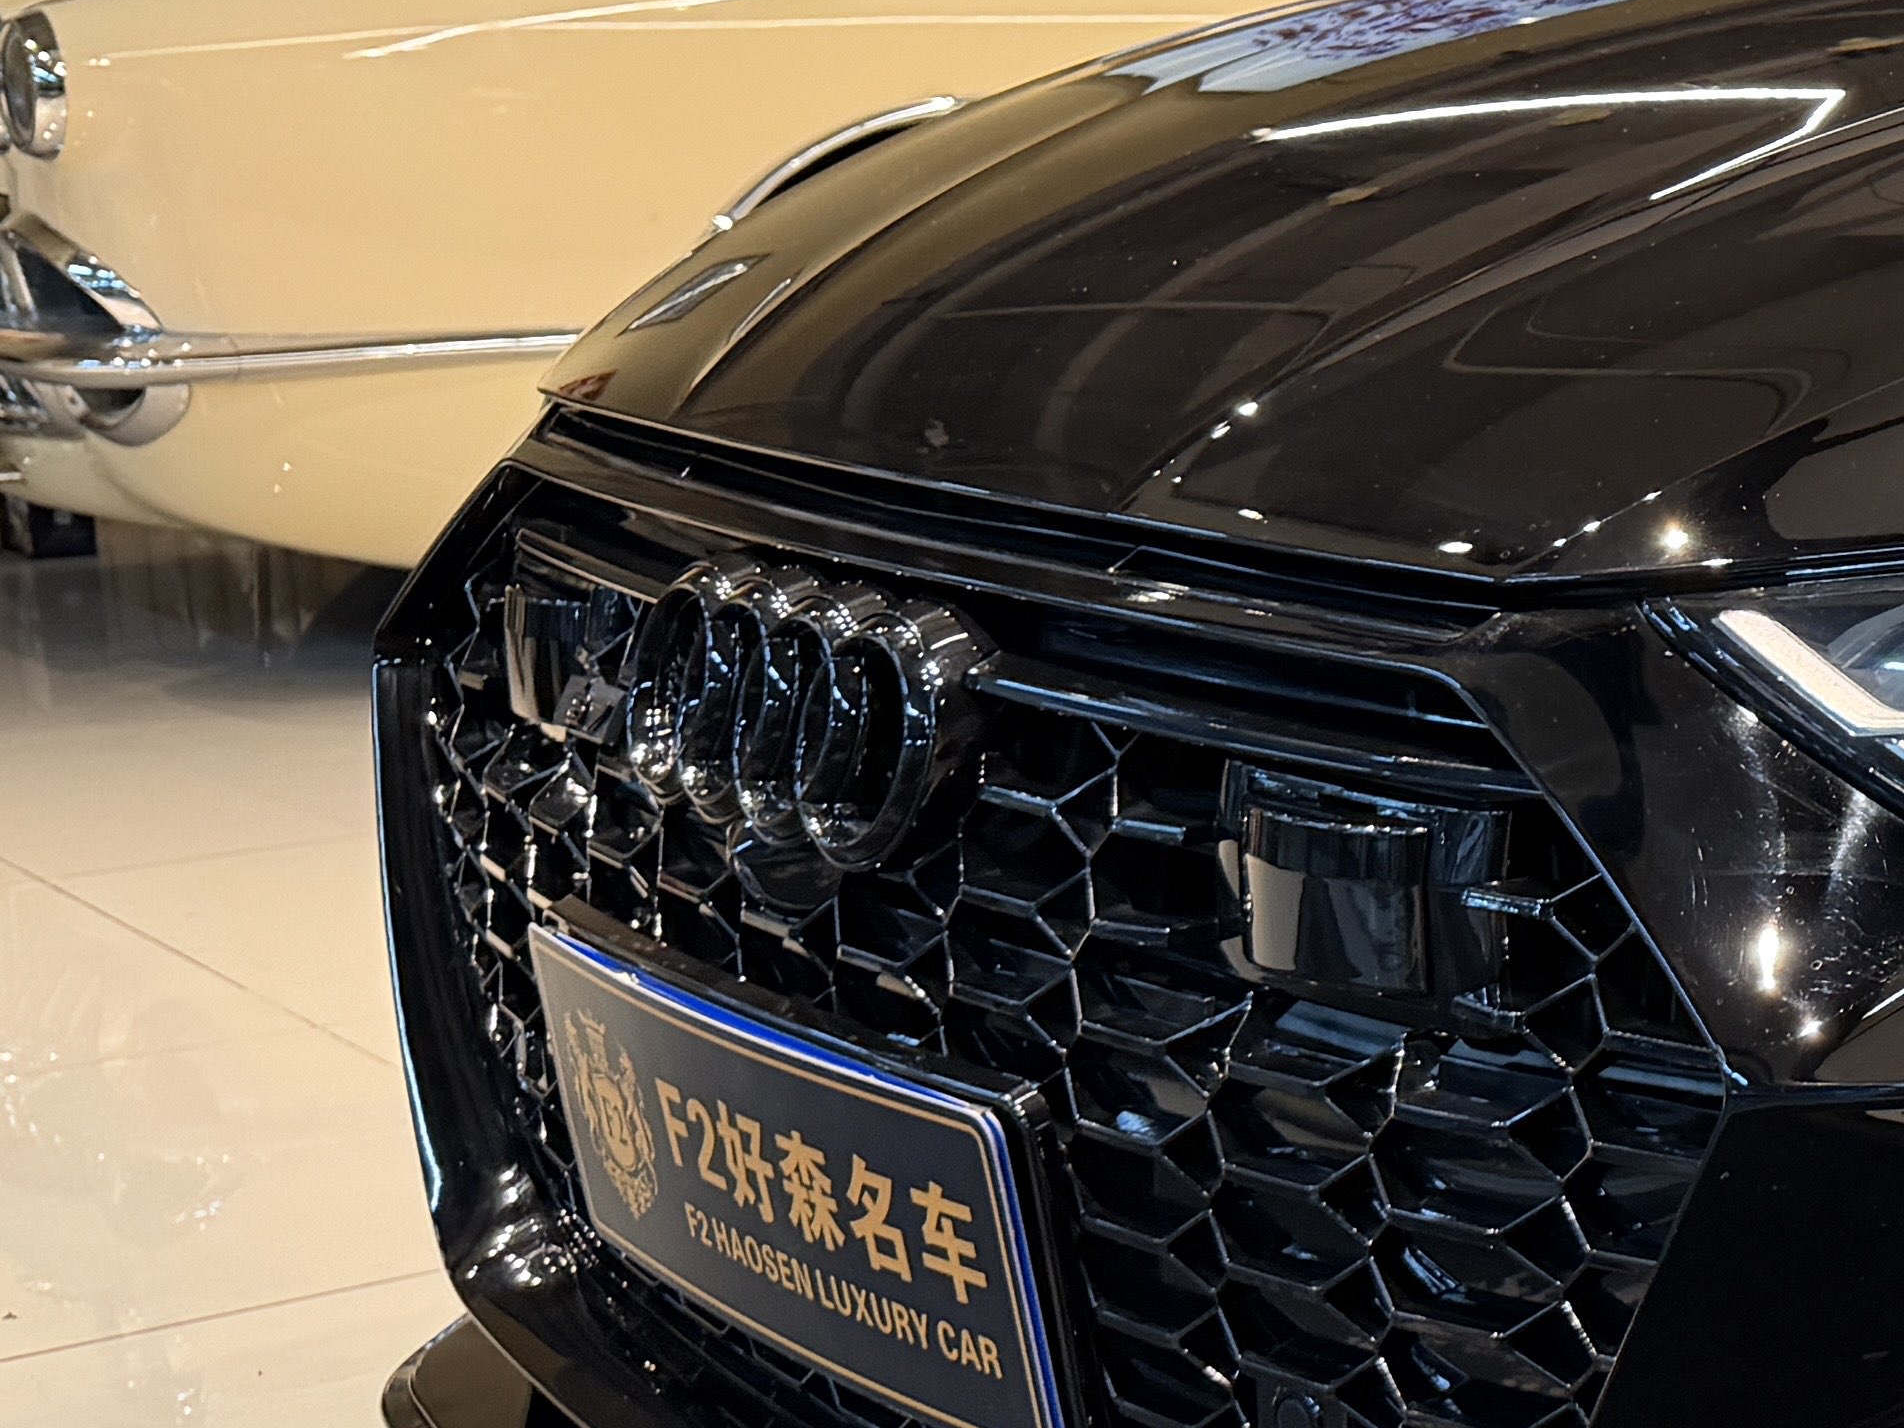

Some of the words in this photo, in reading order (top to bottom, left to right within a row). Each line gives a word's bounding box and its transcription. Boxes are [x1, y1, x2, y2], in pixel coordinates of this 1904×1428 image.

[654, 1077, 988, 1305] F2好森名车
[684, 1201, 713, 1248] F2
[711, 1217, 815, 1301] HAOSEN
[815, 1269, 929, 1351] LUXURY
[936, 1320, 1003, 1380] CAR
